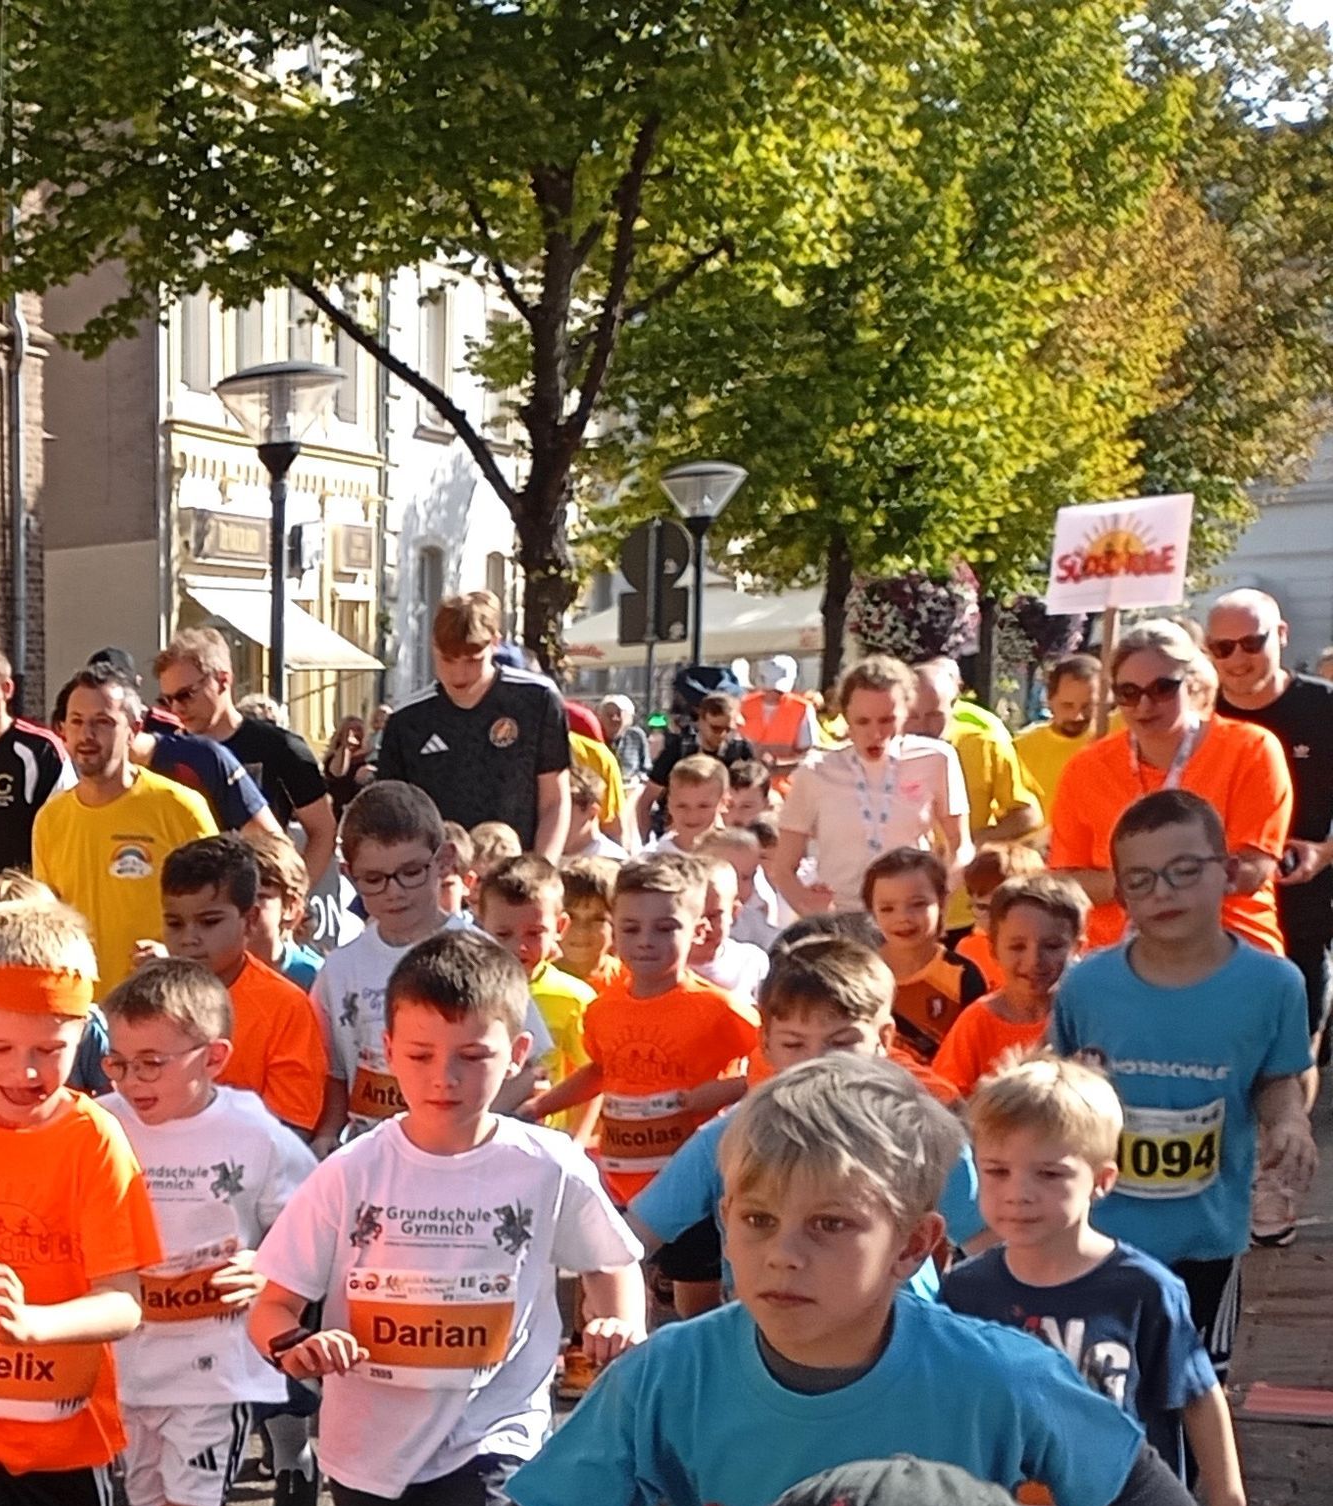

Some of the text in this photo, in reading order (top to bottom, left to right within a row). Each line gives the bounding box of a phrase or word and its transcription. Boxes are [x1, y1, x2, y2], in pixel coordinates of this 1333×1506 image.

[607, 1126, 683, 1147] Nicolas
[386, 1206, 492, 1224] Grundschule
[401, 1220, 475, 1236] Gymnich
[373, 1316, 487, 1347] Darian
